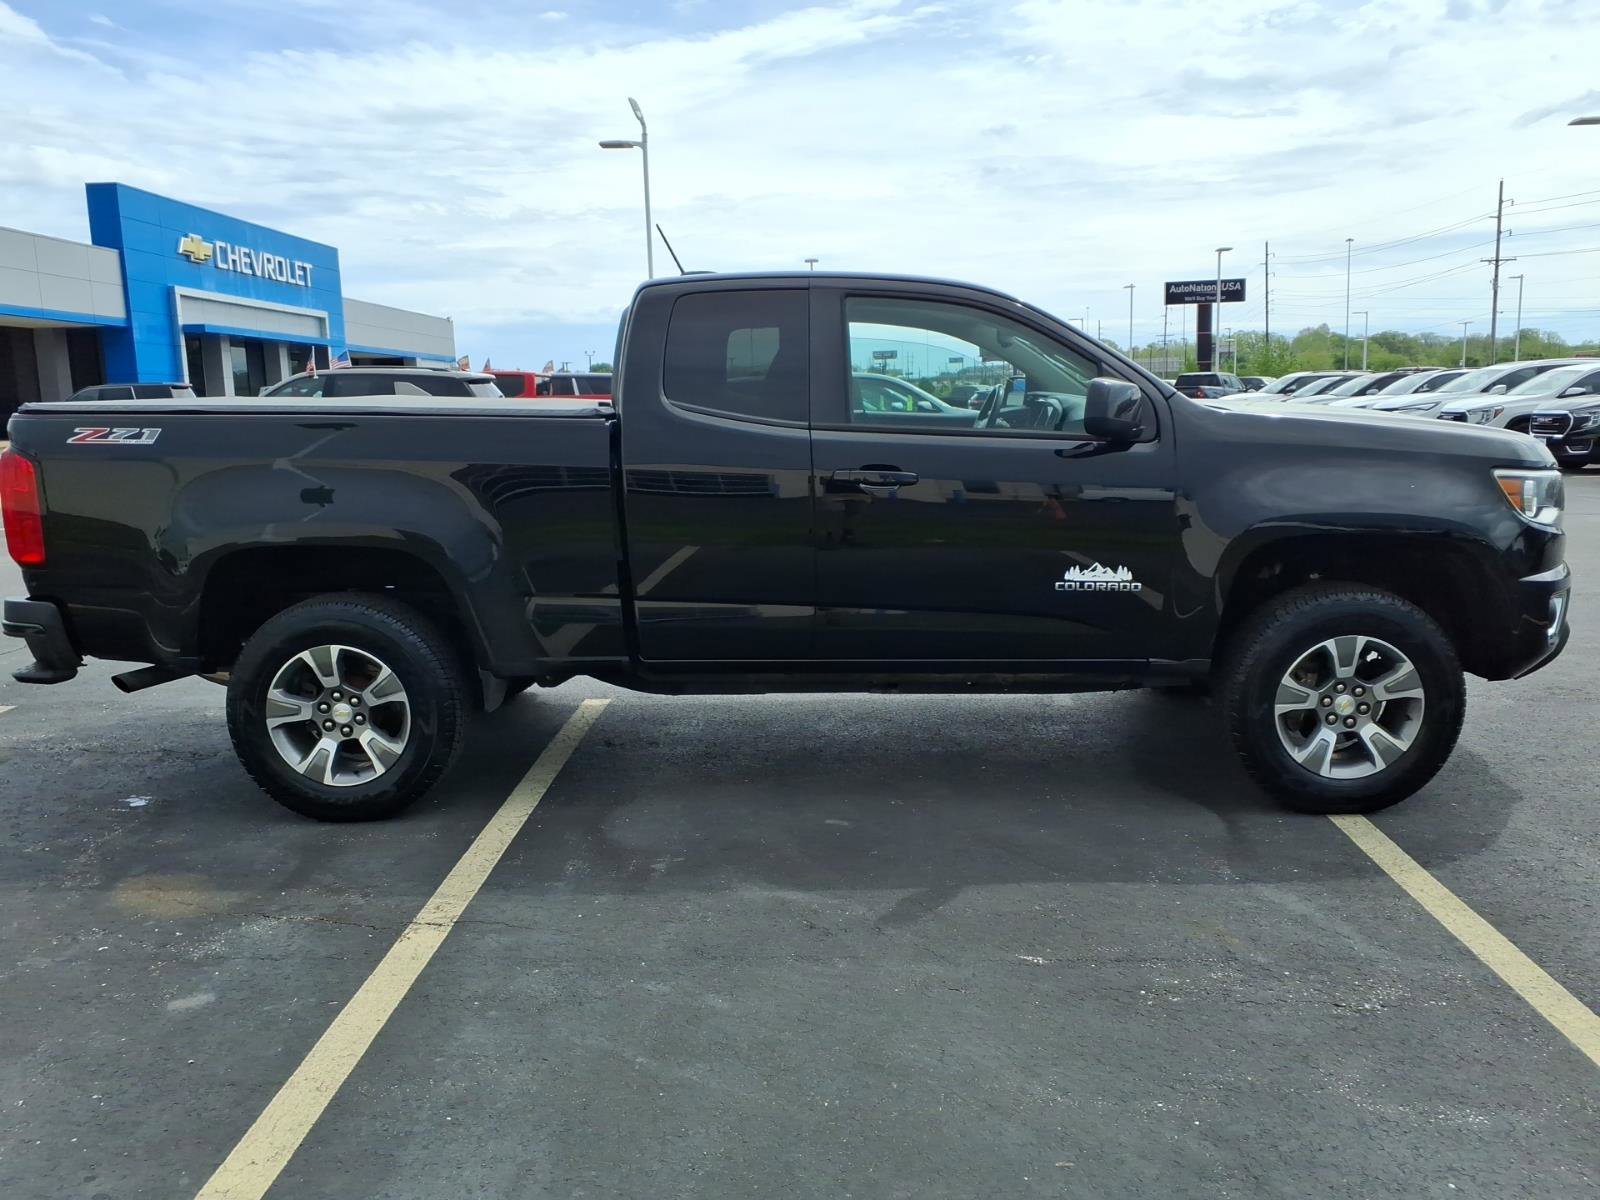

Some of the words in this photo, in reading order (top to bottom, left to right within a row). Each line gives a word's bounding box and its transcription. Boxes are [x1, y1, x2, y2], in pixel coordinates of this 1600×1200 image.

[215, 240, 313, 287] CHEVROLET
[1169, 283, 1217, 293] AutoNation
[1221, 282, 1241, 291] USA
[66, 427, 162, 444] Z71
[1055, 581, 1142, 592] COLORADO
